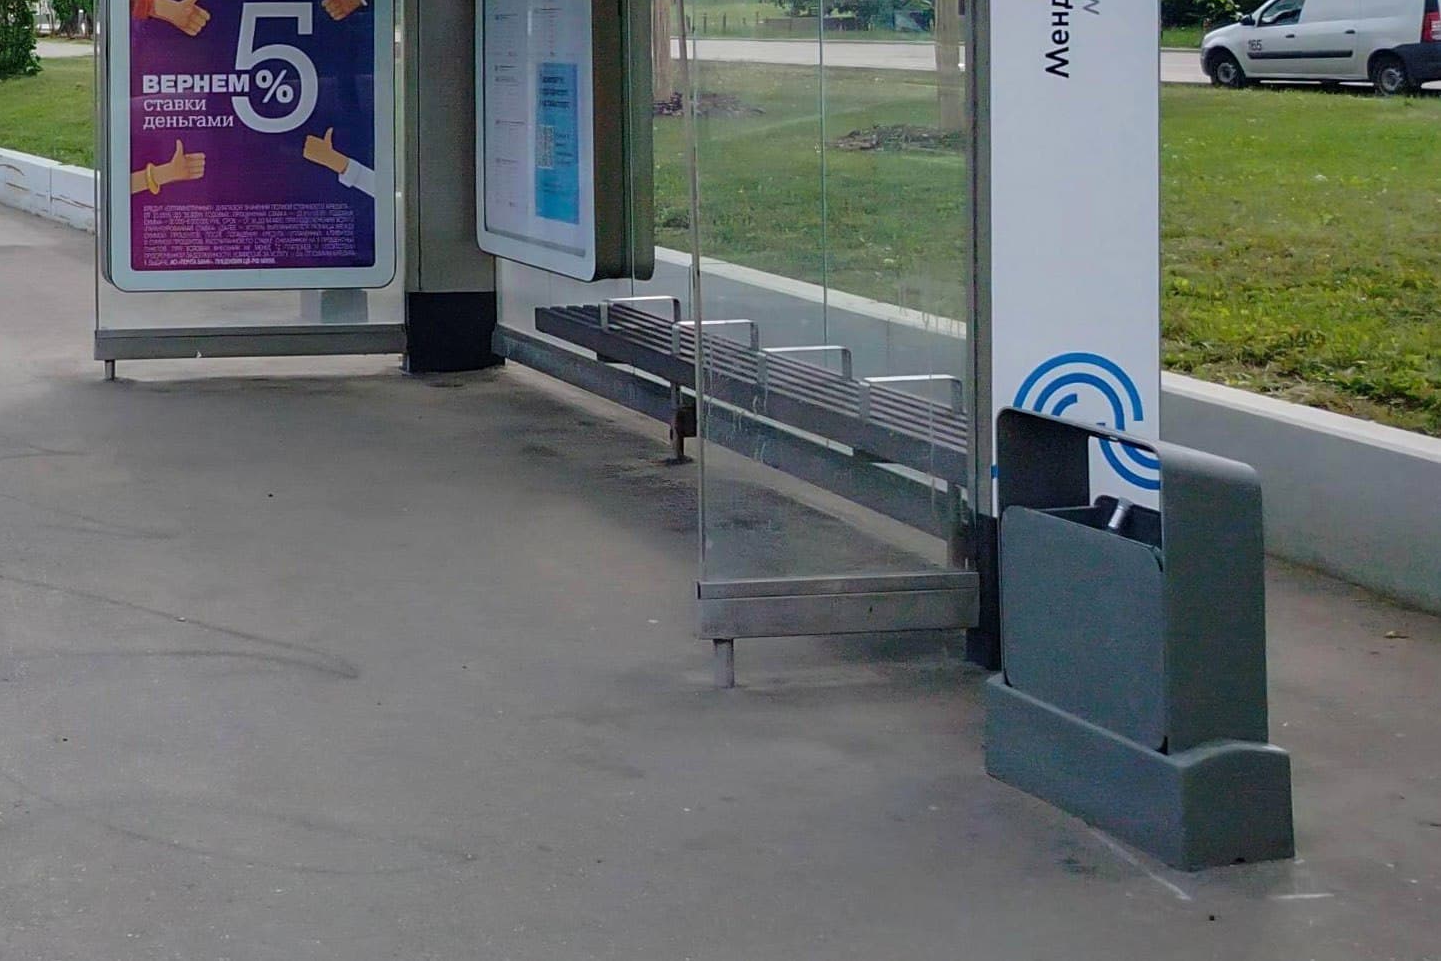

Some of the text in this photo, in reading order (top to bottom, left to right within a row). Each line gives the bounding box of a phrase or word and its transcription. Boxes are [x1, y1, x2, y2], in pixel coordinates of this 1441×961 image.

[142, 74, 250, 94] ВЕРНЕМ
[143, 99, 207, 111] ставки
[142, 114, 235, 130] деньгами
